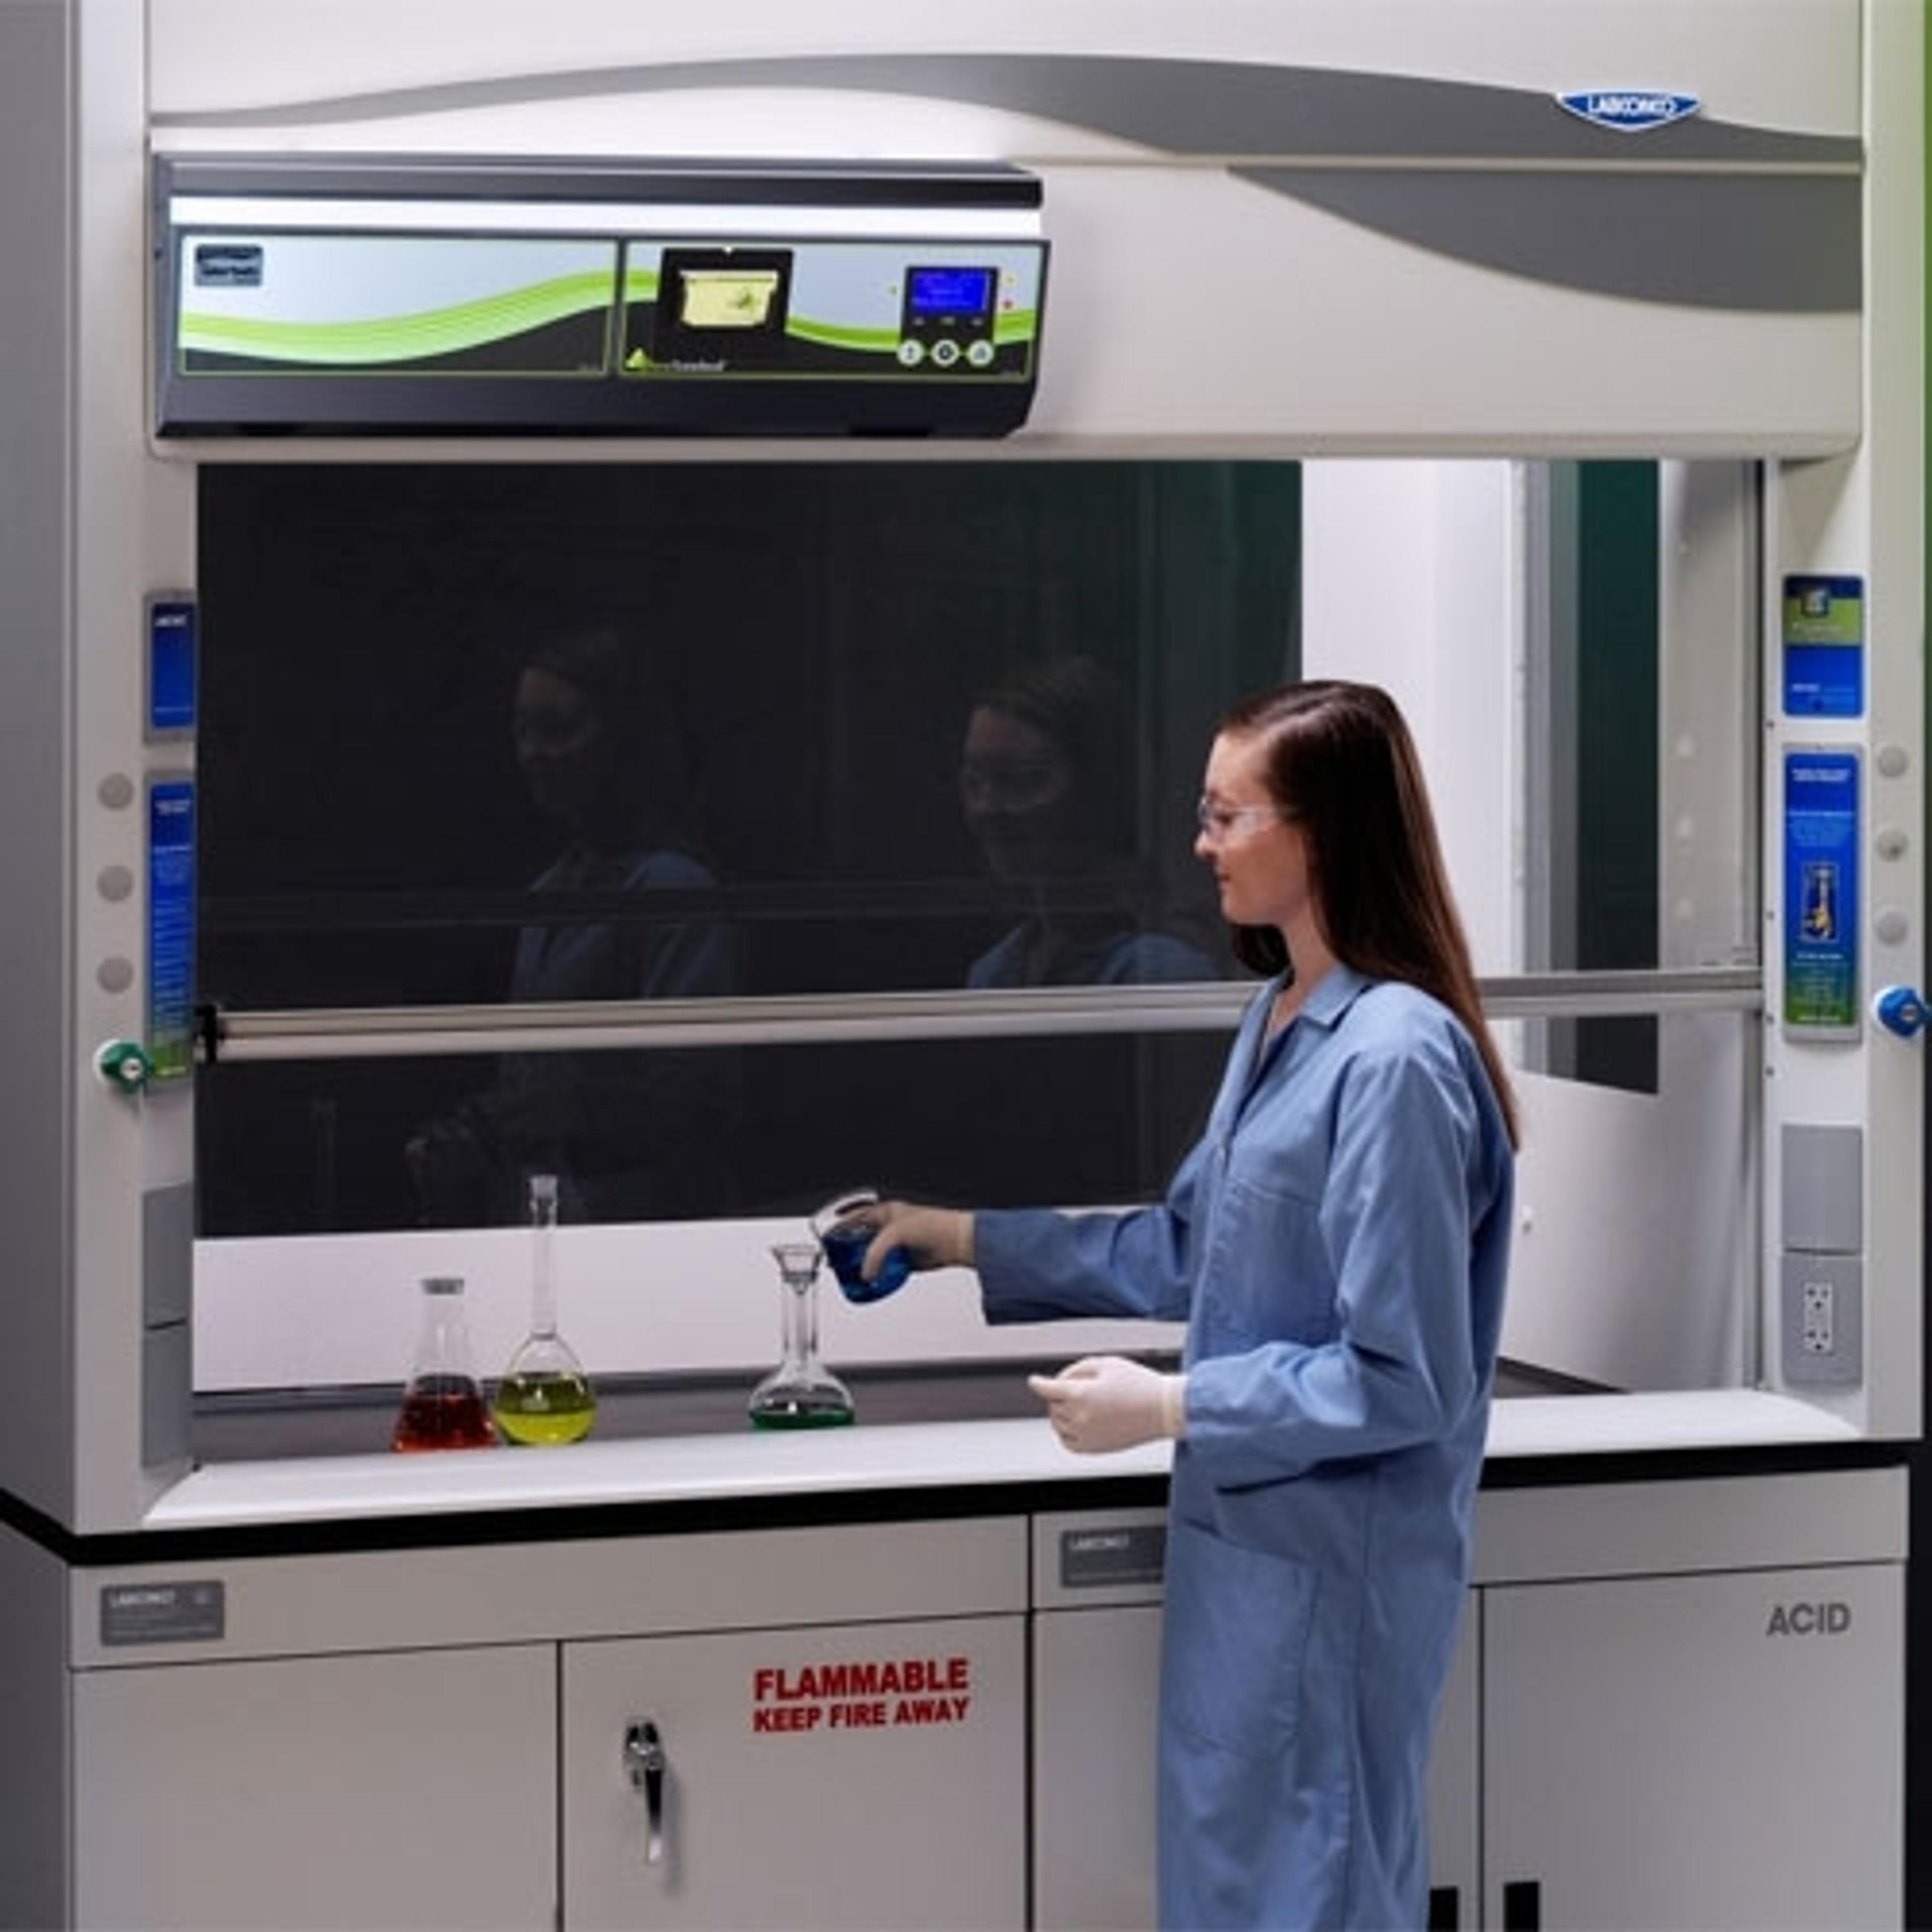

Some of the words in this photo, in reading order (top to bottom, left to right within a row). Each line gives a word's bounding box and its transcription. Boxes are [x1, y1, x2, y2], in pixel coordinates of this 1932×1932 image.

[1766, 1602, 1850, 1636] ACID
[755, 1658, 969, 1701] FLAMMABLE
[754, 1708, 821, 1732] KEEP
[829, 1703, 886, 1728] FIRE
[894, 1698, 969, 1724] AWAY
